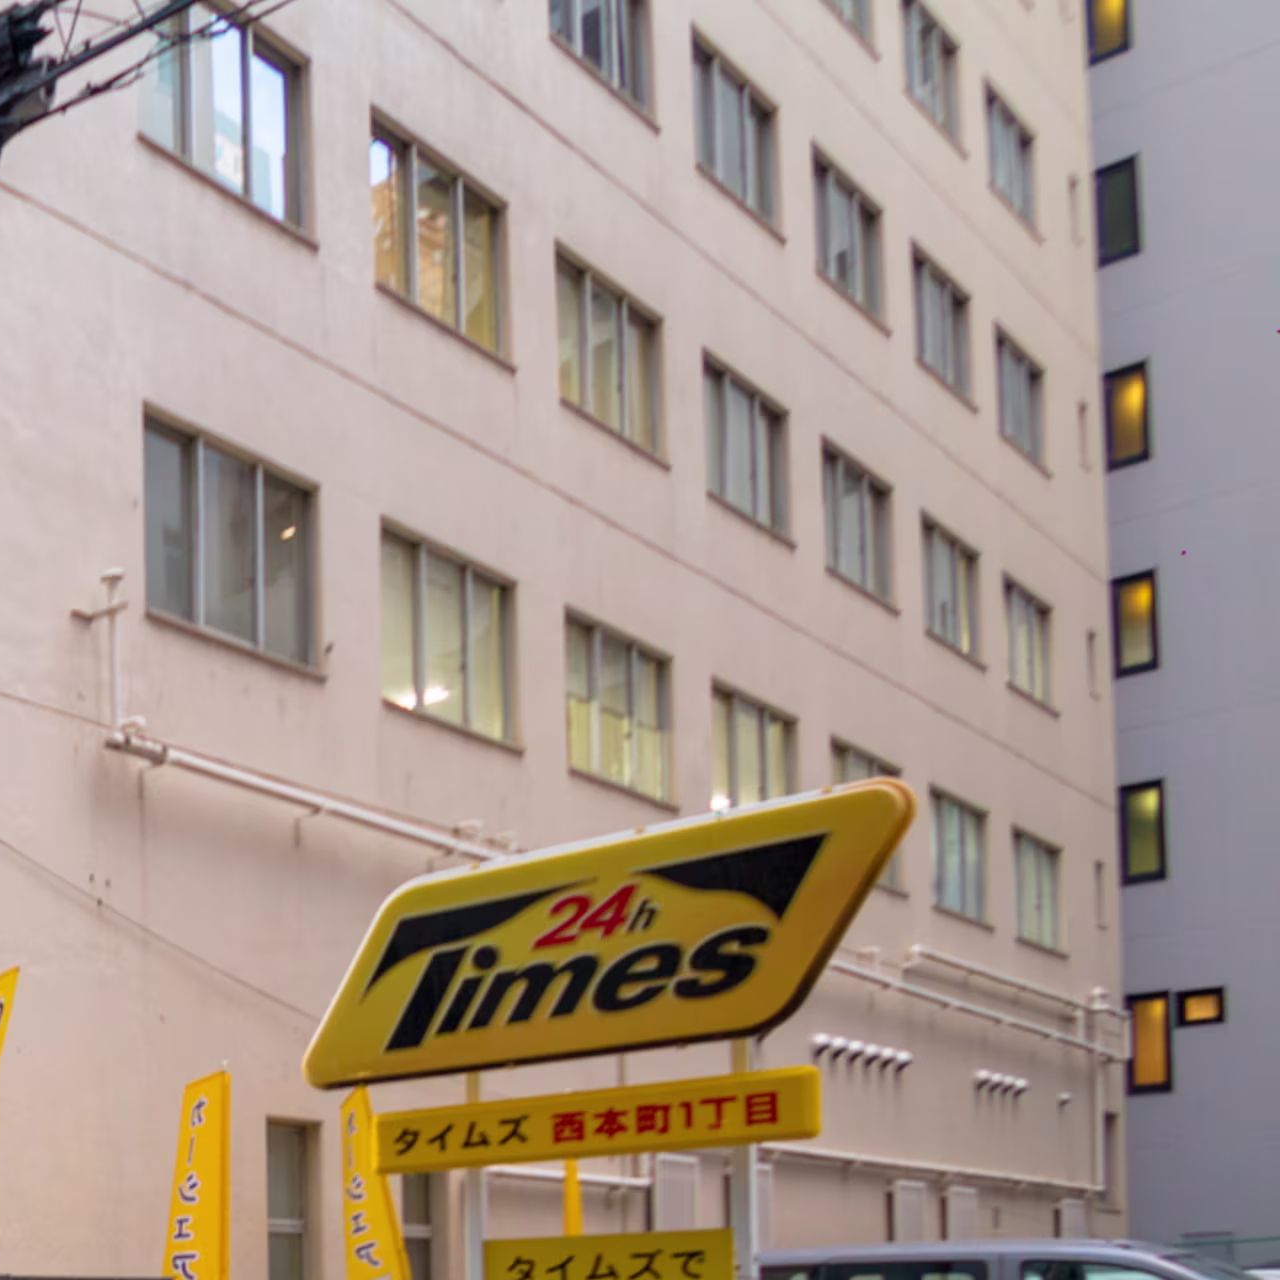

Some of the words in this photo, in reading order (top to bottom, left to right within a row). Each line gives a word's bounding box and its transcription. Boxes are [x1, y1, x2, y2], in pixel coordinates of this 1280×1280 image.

[532, 883, 661, 951] 24h
[384, 925, 770, 1053] Times
[393, 1115, 530, 1157] タイムズ
[550, 1092, 780, 1145] 西本町1丁目
